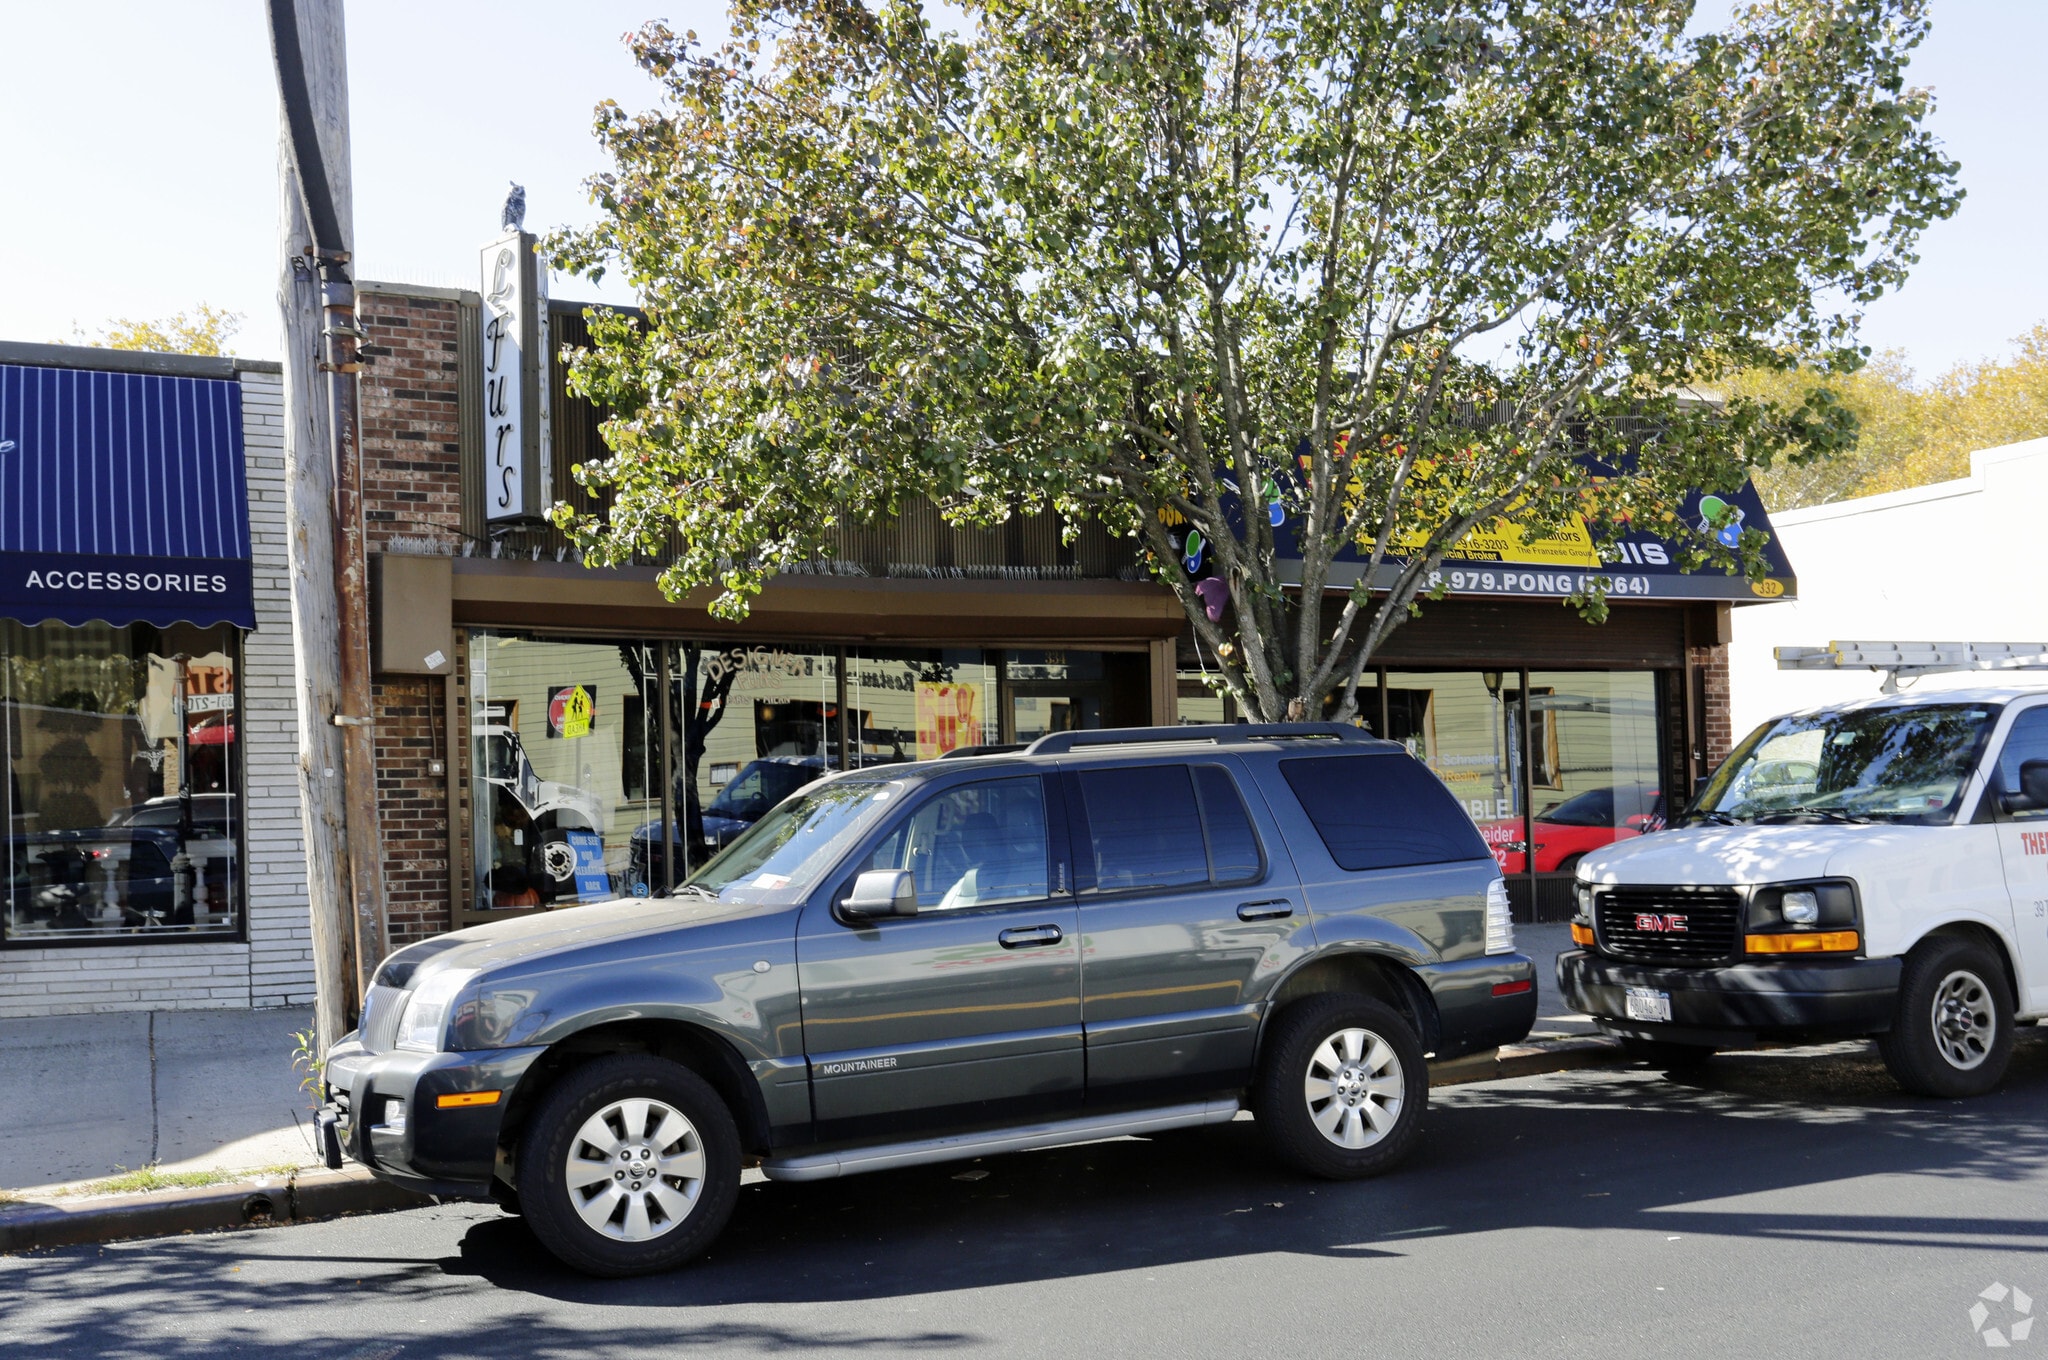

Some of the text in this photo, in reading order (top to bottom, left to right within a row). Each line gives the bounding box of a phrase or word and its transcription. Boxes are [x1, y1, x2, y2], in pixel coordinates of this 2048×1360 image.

[1457, 538, 1509, 550] -916-3203
[1516, 546, 1593, 557] The Franzese Group
[1467, 550, 1497, 561] Broker
[25, 570, 227, 593] ACCESSORIES
[1401, 569, 1572, 592] 8.979.PONG
[1760, 582, 1777, 595] 332
[706, 645, 806, 681] DESIGNER
[735, 669, 784, 691] FURS
[762, 697, 791, 705] MILAN
[918, 683, 982, 756] 50%
[1443, 752, 1501, 766] Schneider
[1445, 770, 1481, 784] Realty
[1460, 798, 1515, 820] ABLE.
[1481, 825, 1515, 843] eider
[2021, 831, 2048, 856] THE
[1635, 913, 1689, 932] GMC
[823, 1057, 898, 1075] MOUNTAINEER
